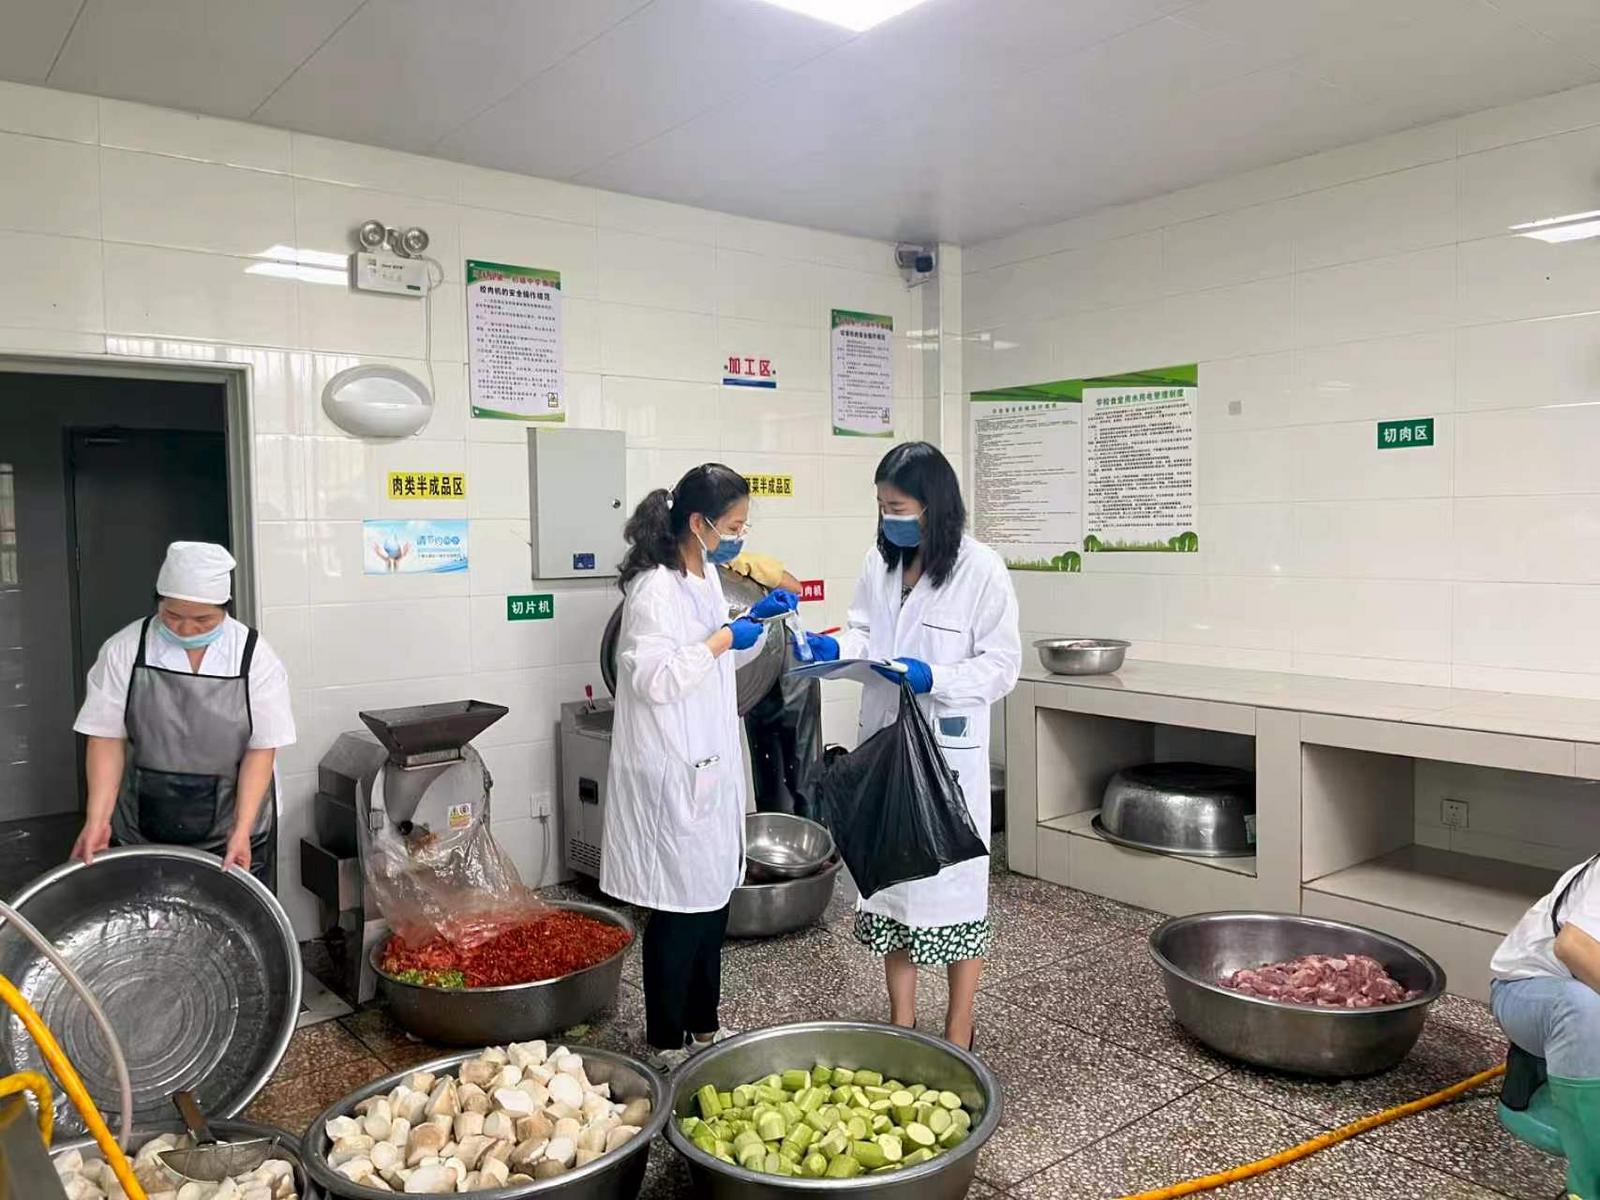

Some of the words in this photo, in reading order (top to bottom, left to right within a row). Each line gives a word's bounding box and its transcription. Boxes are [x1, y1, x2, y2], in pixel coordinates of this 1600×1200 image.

[480, 285, 551, 301] 绞肉机的安全操作规范
[728, 356, 771, 377] 加工区
[1384, 425, 1428, 443] 切肉区
[392, 475, 464, 496] 肉类半成品区
[800, 584, 823, 598] 肉机
[511, 599, 551, 615] 切片机
